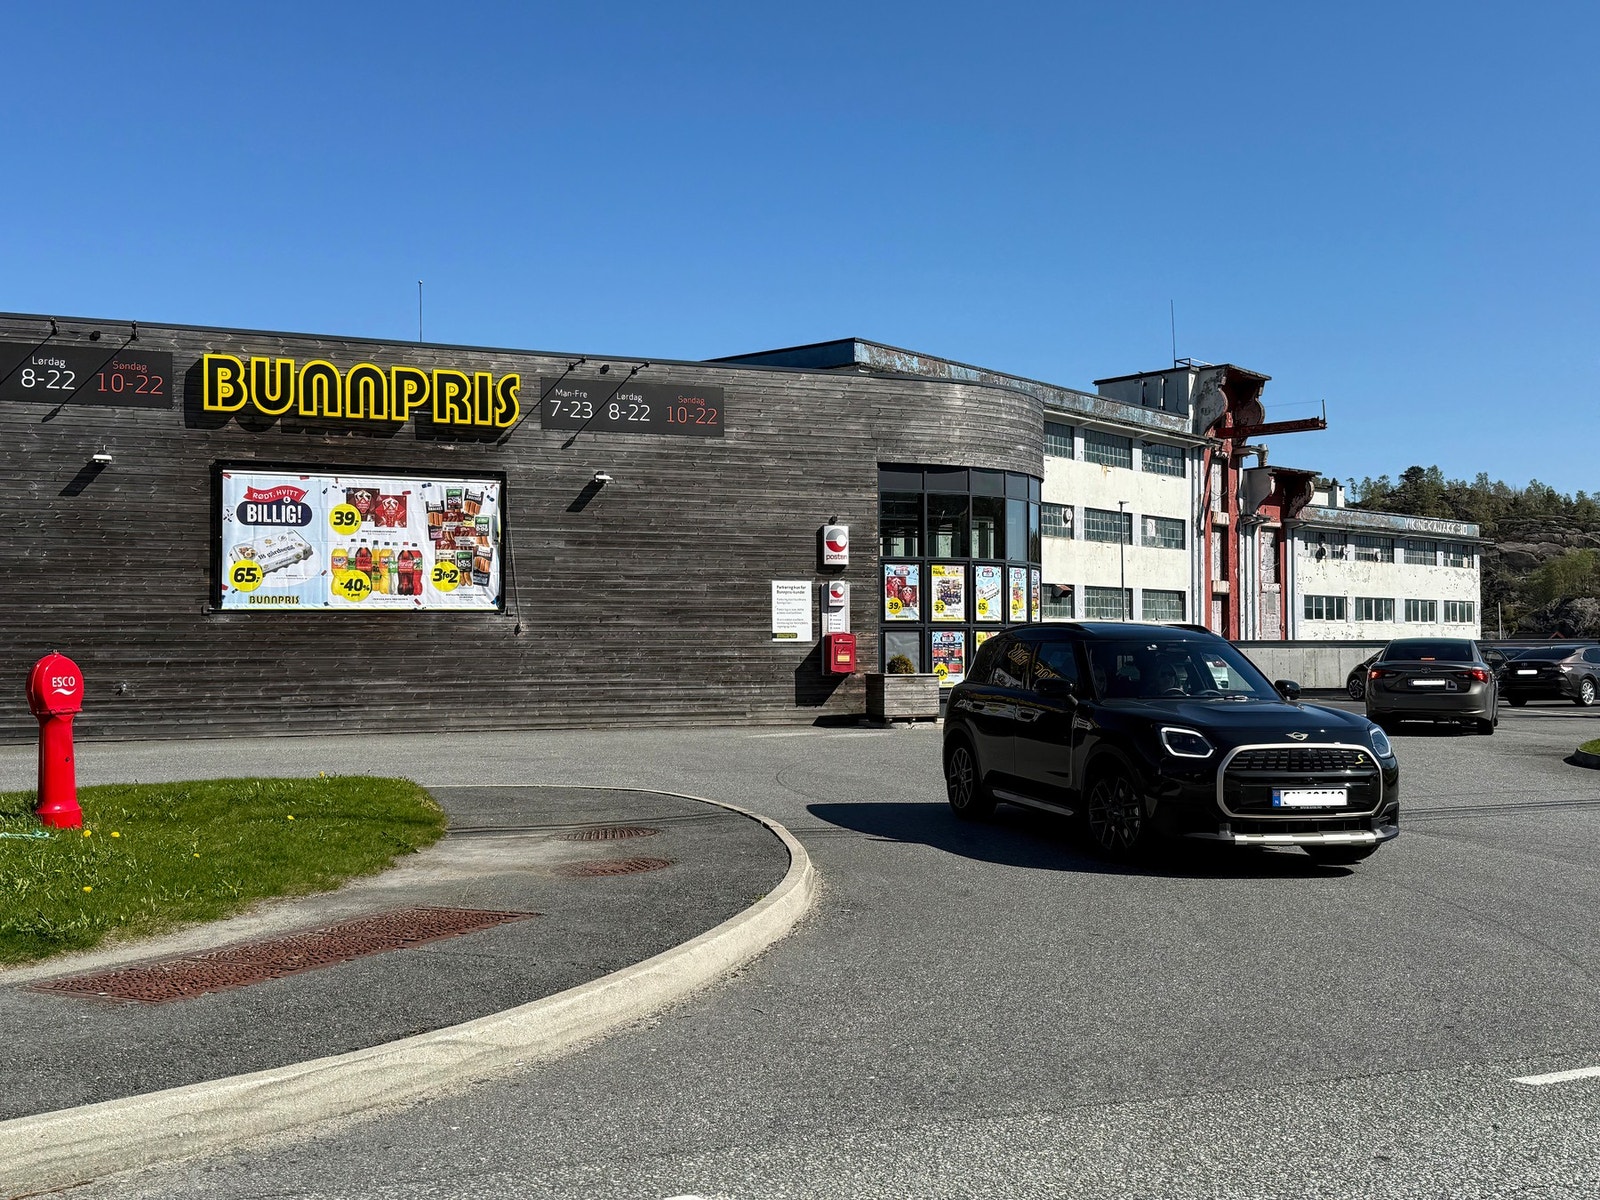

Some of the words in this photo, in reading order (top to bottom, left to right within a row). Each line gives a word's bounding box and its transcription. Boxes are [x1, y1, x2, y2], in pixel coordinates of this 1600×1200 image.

[32, 356, 66, 368] Lørdag
[112, 360, 147, 373] Søndag
[21, 368, 76, 390] 8-22
[97, 372, 163, 395] 10-22
[203, 353, 521, 428] BUNNPRIS
[555, 388, 588, 398] Man-Fre
[616, 392, 643, 403] Lørdag
[677, 395, 705, 406] Søndag
[550, 400, 593, 419] 7-23
[608, 403, 651, 422] 8-22
[666, 405, 718, 425] 10-22
[252, 492, 276, 500] RØDT,
[247, 503, 302, 523] BILLIG!
[826, 553, 847, 561] posten
[249, 595, 300, 605] BUNNPRIS
[52, 676, 76, 688] ESCO
